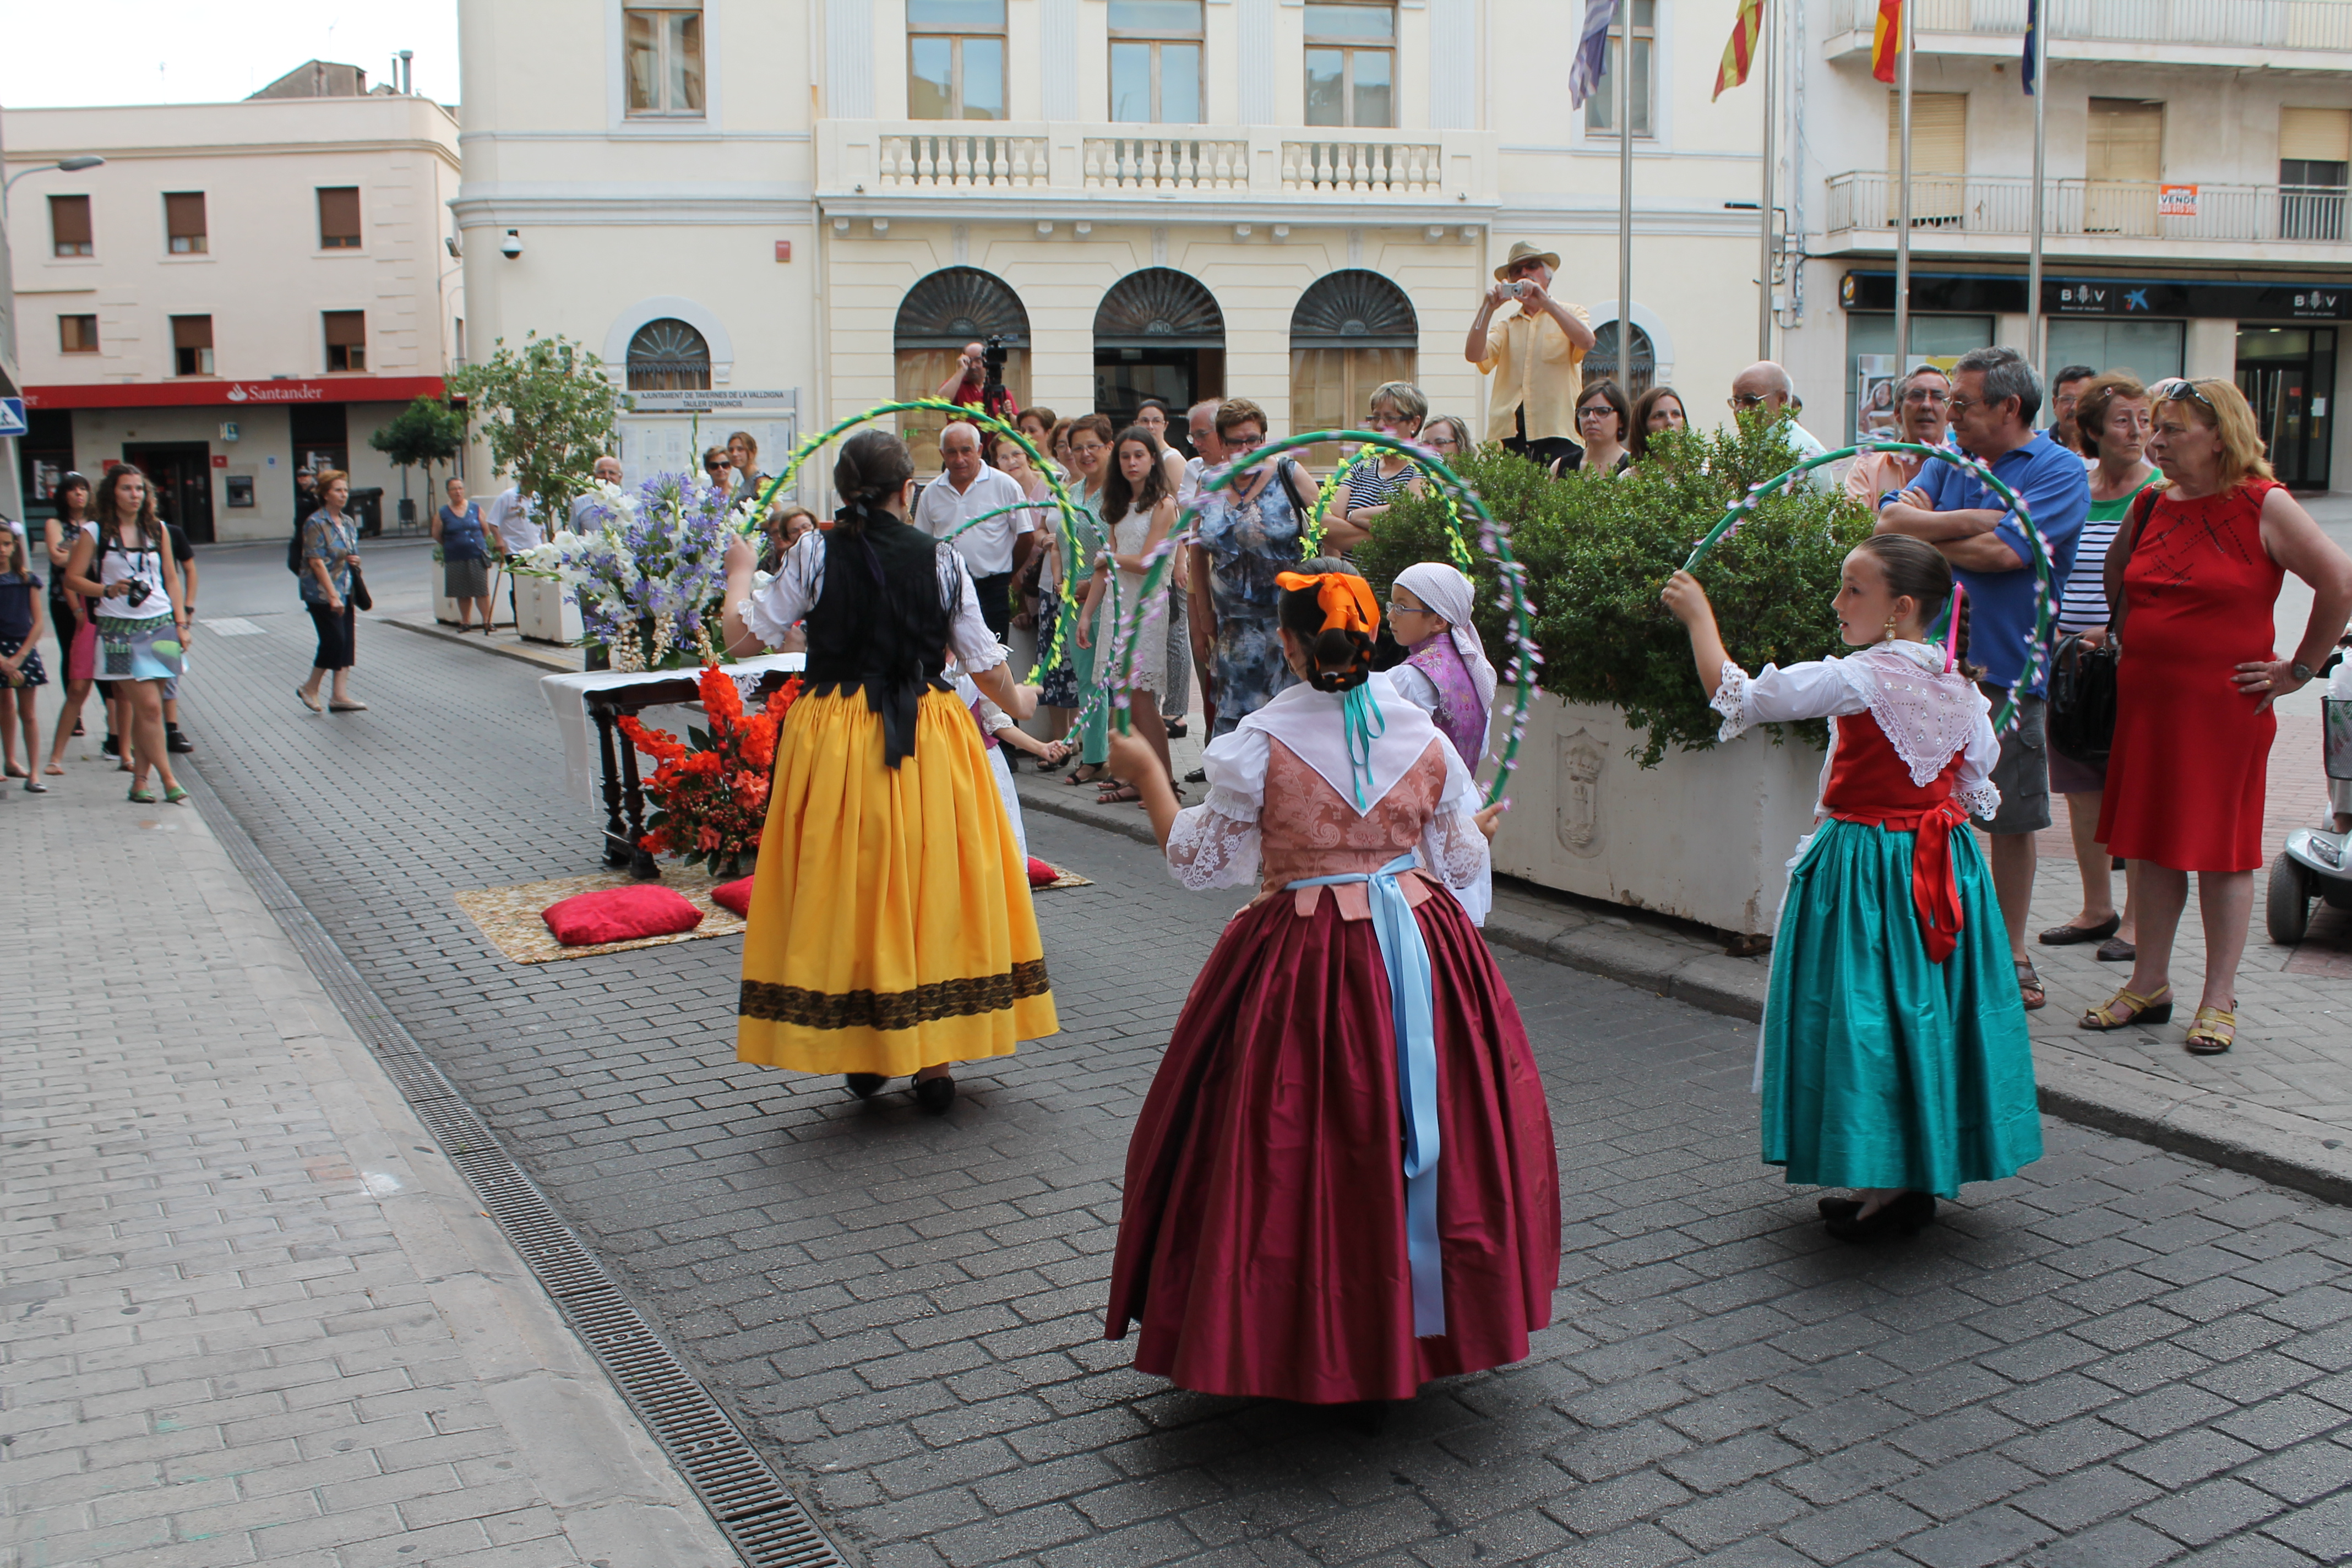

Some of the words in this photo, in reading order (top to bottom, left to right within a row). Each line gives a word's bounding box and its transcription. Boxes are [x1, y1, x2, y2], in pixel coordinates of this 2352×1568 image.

[2161, 195, 2198, 204] VENDE
[2061, 289, 2072, 301] B
[2094, 290, 2105, 302] V
[2294, 295, 2305, 307] B
[2326, 296, 2337, 307] V
[249, 383, 323, 400] Santander
